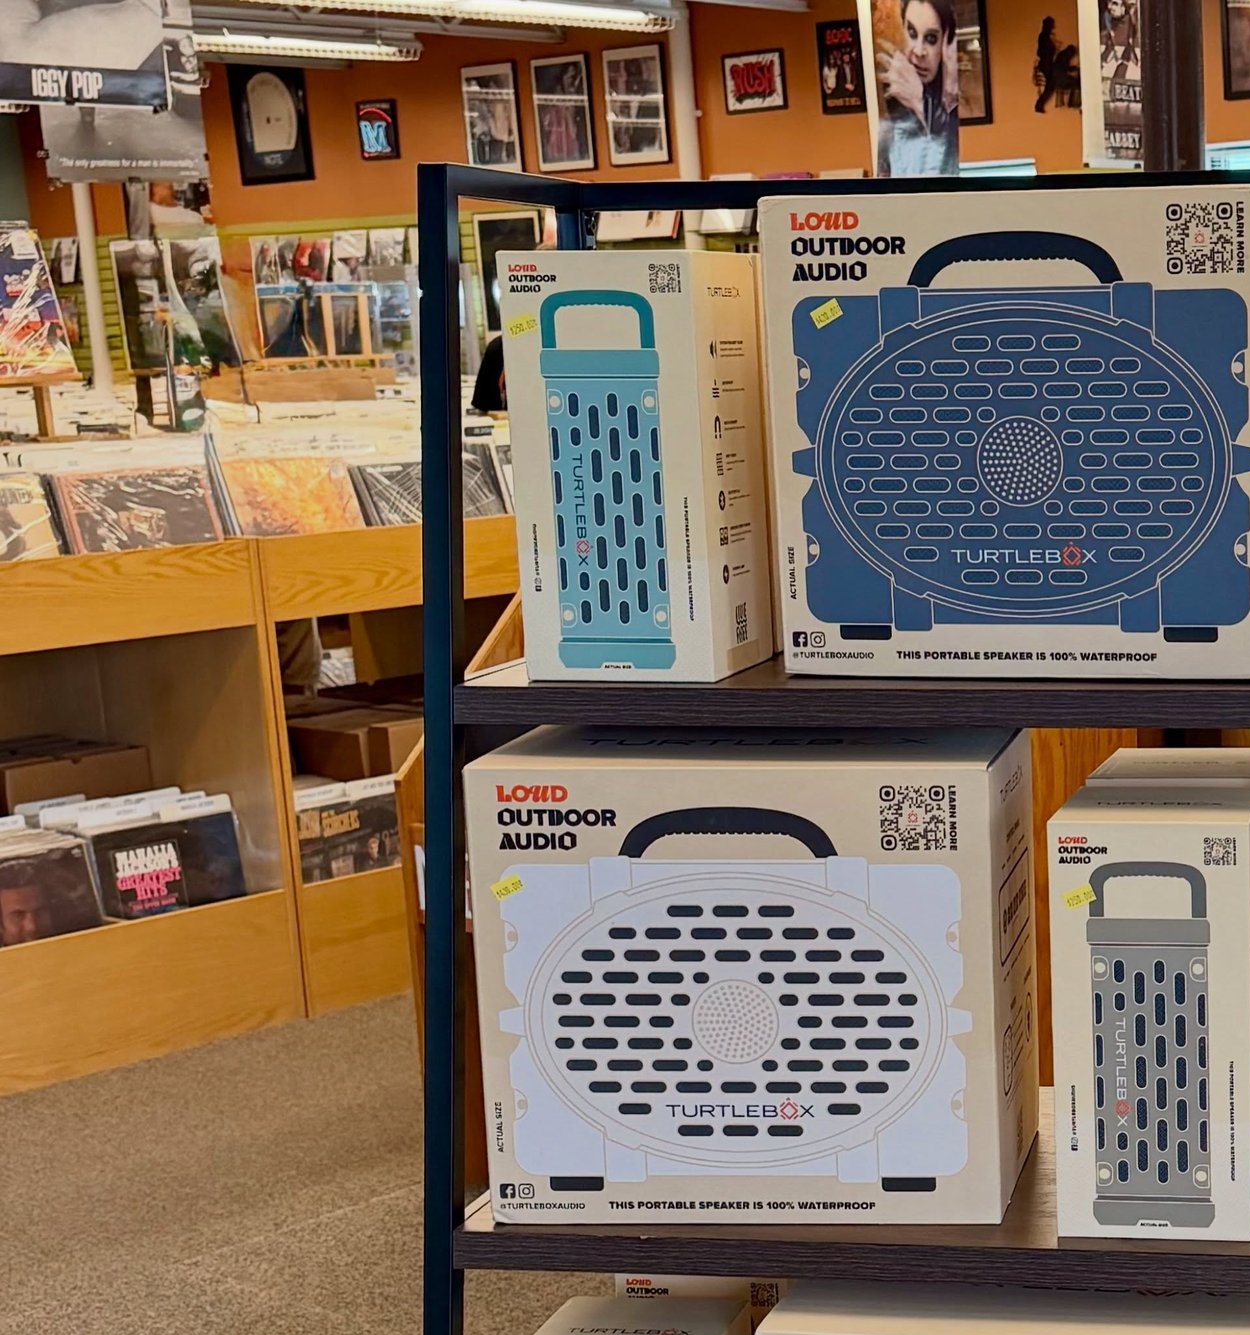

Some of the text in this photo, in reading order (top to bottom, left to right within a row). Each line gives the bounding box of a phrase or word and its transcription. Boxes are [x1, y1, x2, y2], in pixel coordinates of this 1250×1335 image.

[31, 68, 103, 99] IGGY POP
[729, 60, 775, 97] RUSH
[790, 211, 859, 231] LOUD
[791, 236, 906, 256] OUTDOOR
[1236, 201, 1245, 274] LEARN MORE
[508, 264, 537, 273] LOUD
[793, 261, 867, 282] AUDIO
[508, 274, 557, 283] OUTDOOR
[509, 284, 542, 293] AUDIO
[572, 453, 592, 567] TURTLEBOX
[951, 541, 1097, 566] TURTLEBOX
[792, 651, 874, 660] @TURTLEBOXAUDIO
[897, 651, 1157, 662] THIS PORTABLE SPEAKER IS 100% WATERPROOF
[496, 784, 568, 803] LOUD
[497, 808, 617, 827] OUTDOOR
[948, 785, 958, 851] LEARN MORE
[499, 830, 577, 851] AUDIO
[1058, 836, 1088, 844] LOUD
[1058, 847, 1107, 855] OUTDOOR
[1058, 856, 1091, 864] AUDIO
[1115, 1017, 1132, 1127] TURTLEBOX
[665, 1097, 815, 1120] TURTLEBOX
[609, 1201, 876, 1210] THIS PORTABLE SPEAKER IS 100% WATERPROOF
[626, 1287, 669, 1295] OUTDOOR
